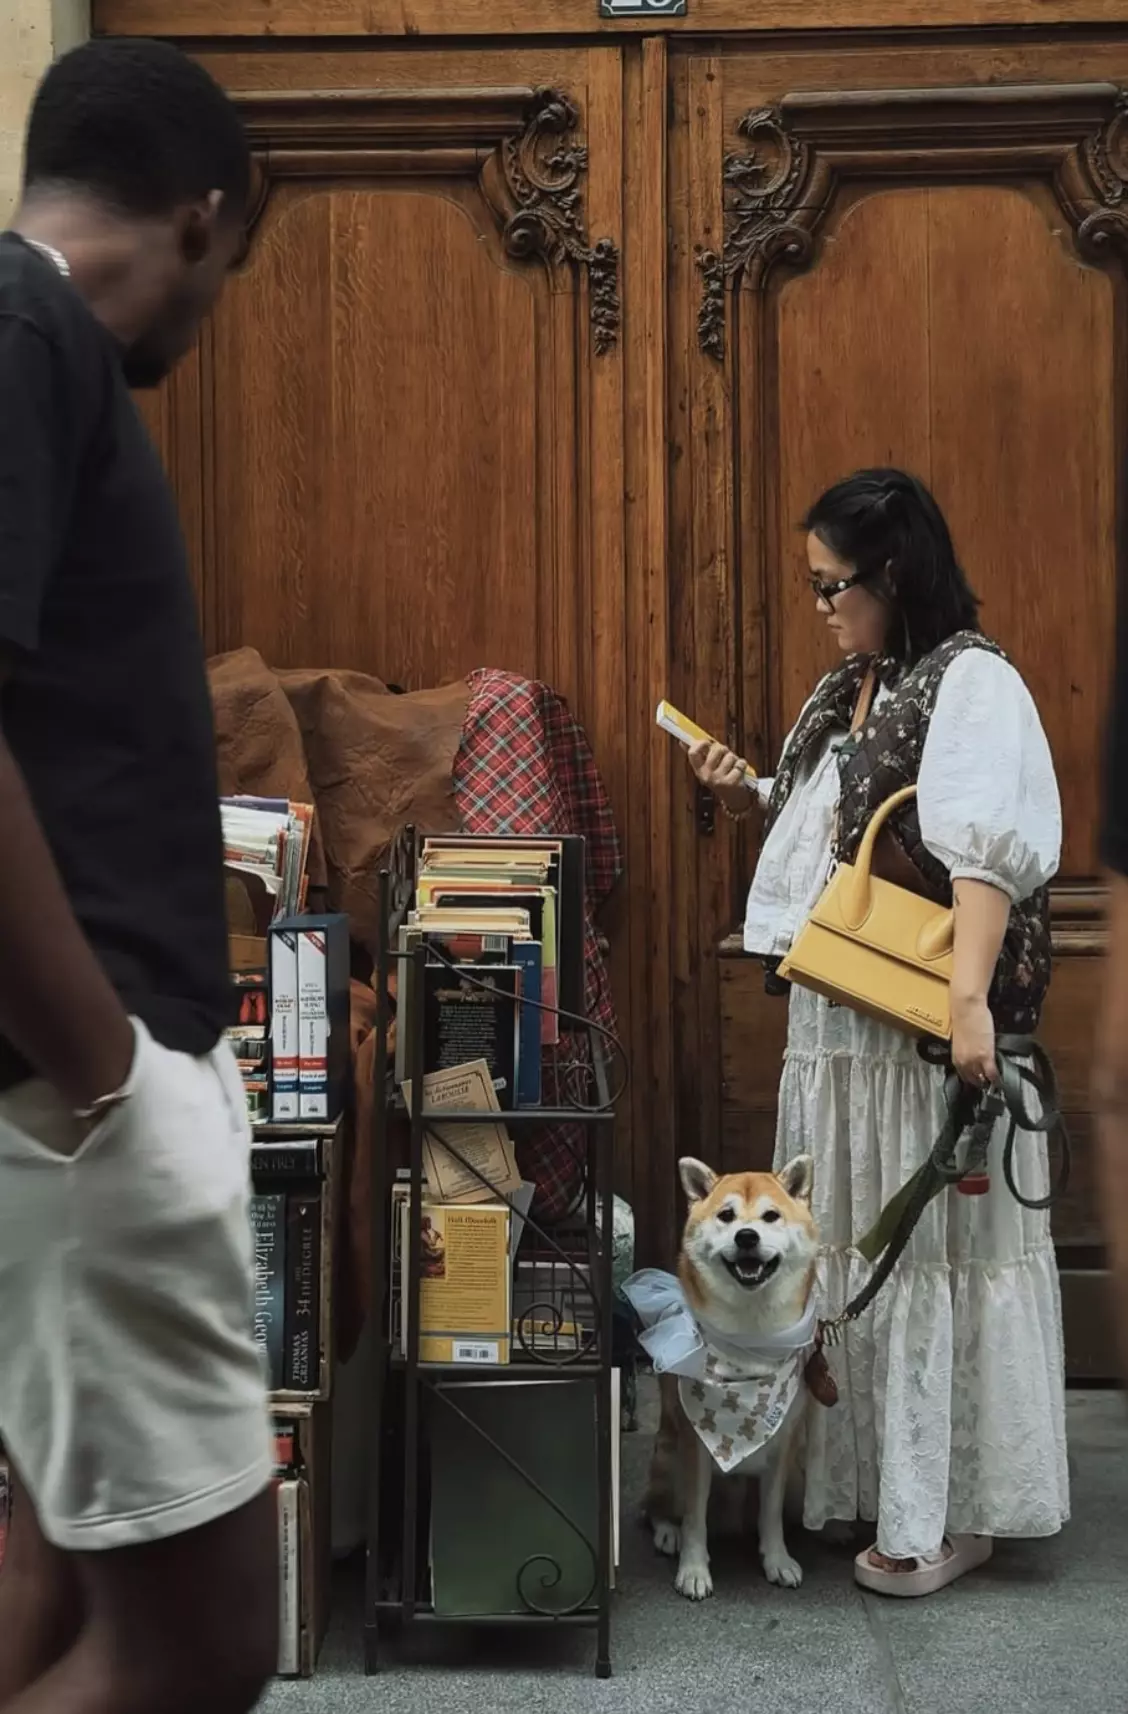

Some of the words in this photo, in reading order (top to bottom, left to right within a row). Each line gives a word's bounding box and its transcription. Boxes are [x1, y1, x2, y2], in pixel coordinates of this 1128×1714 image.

[255, 1232, 275, 1306] Elizabeth
[254, 1312, 273, 1356] Geor
[292, 1334, 300, 1380] THOMAS
